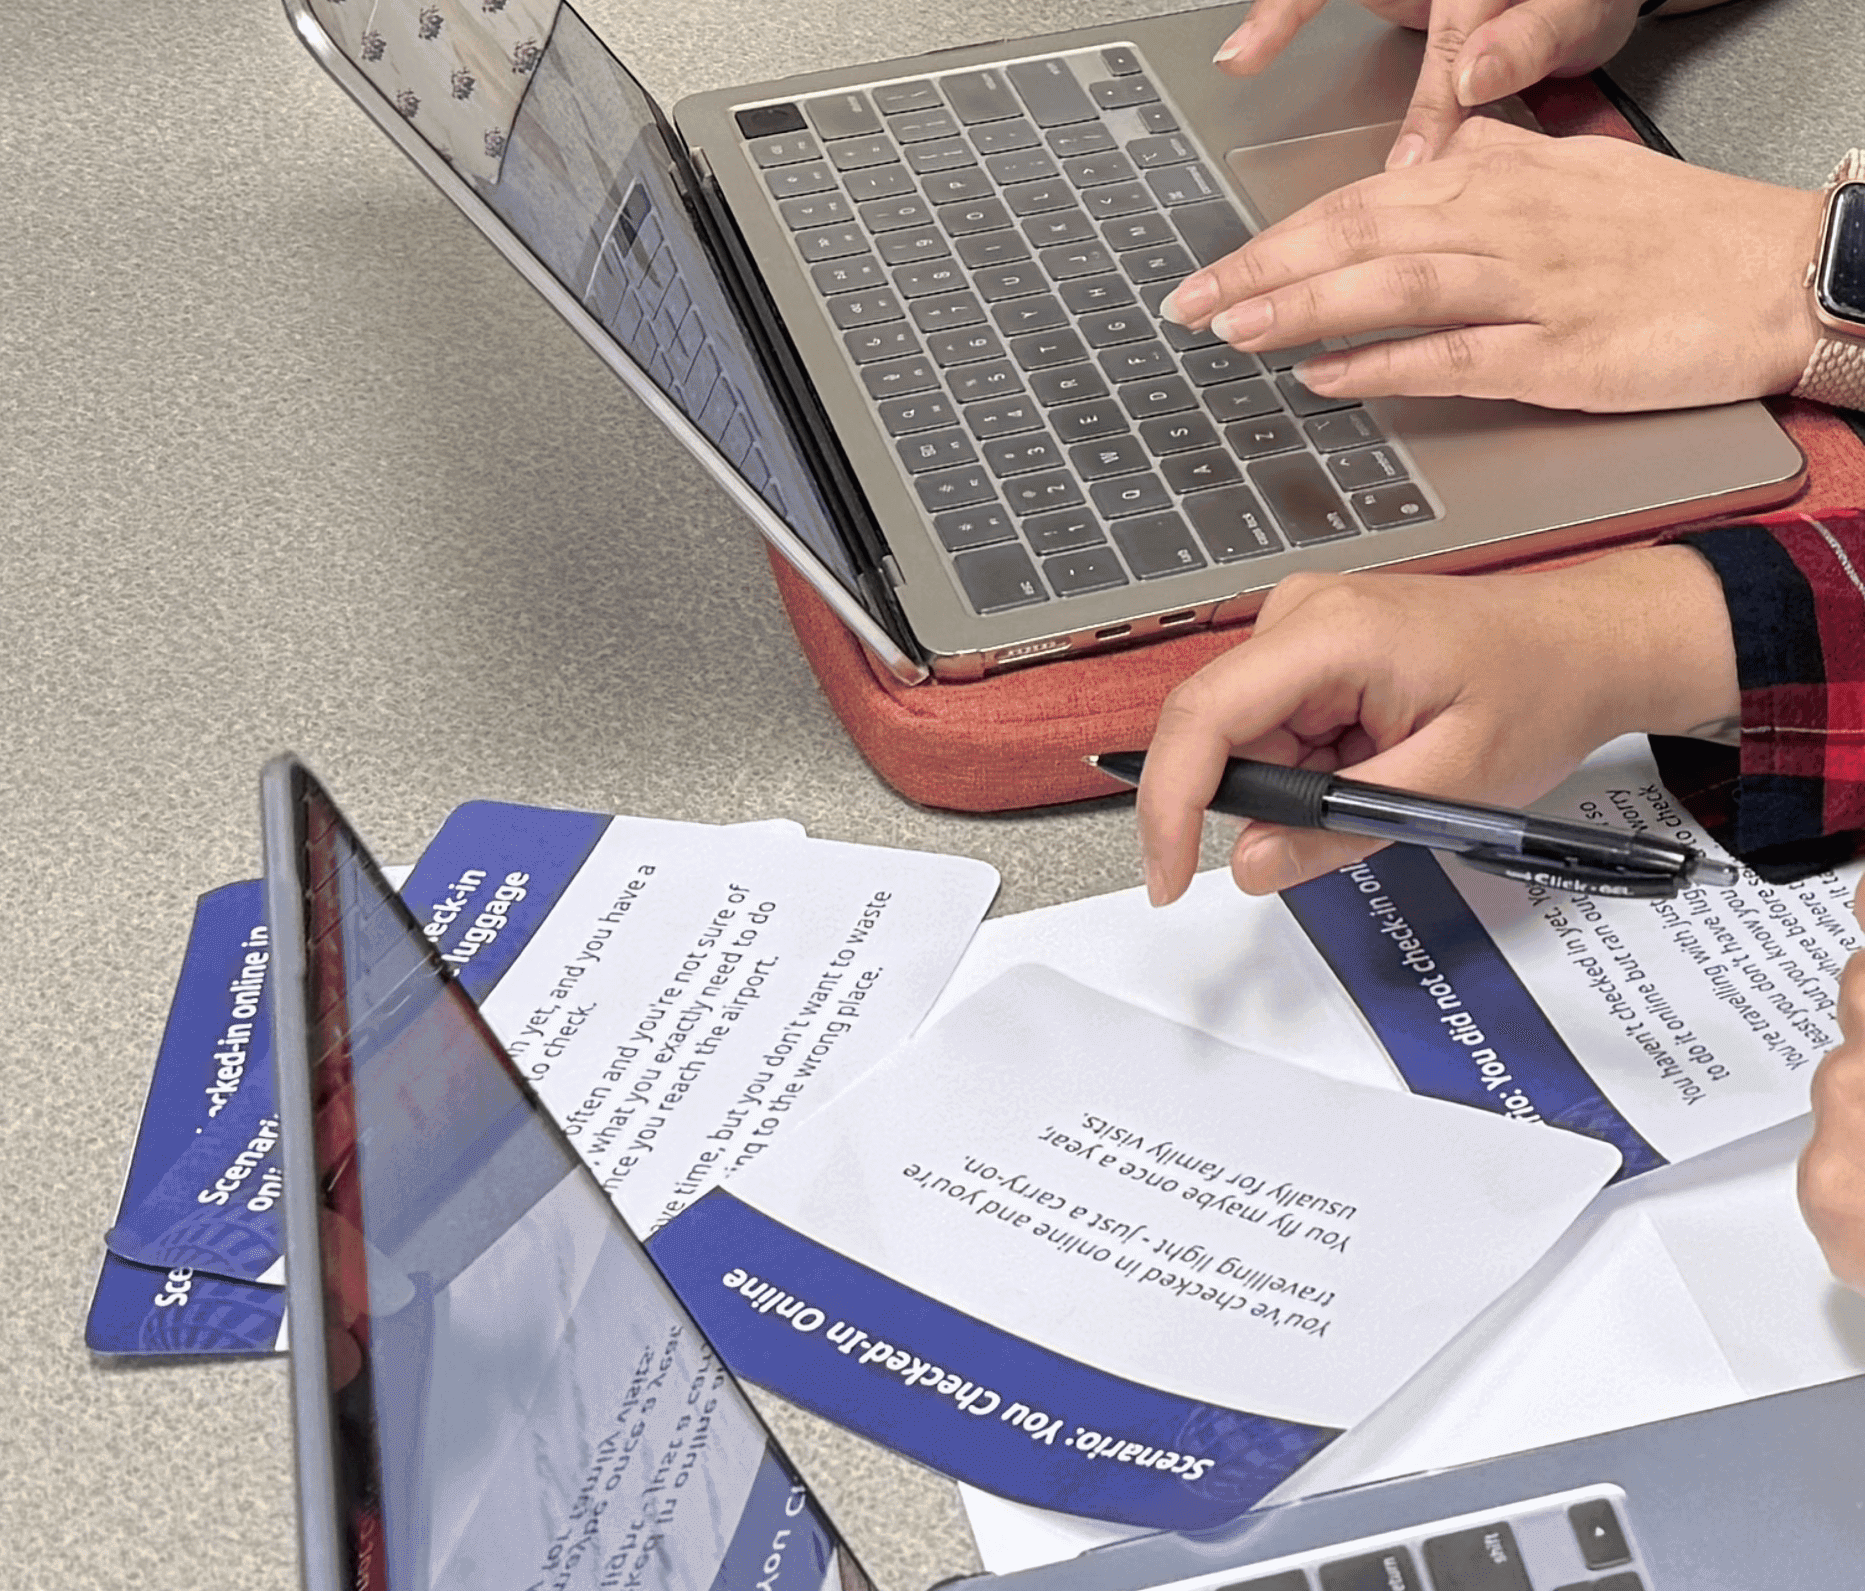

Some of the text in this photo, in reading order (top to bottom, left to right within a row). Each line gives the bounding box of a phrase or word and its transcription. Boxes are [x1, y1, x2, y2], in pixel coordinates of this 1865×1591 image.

[1340, 864, 1382, 894] onl
[1829, 886, 1851, 900] it
[423, 869, 487, 943] eck-in
[440, 871, 529, 963] luggage
[1544, 907, 1584, 939] yet.
[1649, 893, 1693, 930] just
[1682, 889, 1713, 917] lug
[1720, 889, 1761, 919] you
[1757, 889, 1808, 939] before
[1798, 892, 1846, 938] where
[241, 926, 269, 948] in
[520, 1005, 562, 1038] yet,
[550, 965, 587, 1000] and
[576, 929, 614, 964] you
[598, 880, 647, 924] have
[637, 865, 657, 877] a
[1369, 896, 1436, 973] check-in
[1566, 938, 1588, 957] in
[1673, 929, 1712, 966] with
[1704, 916, 1743, 956] have
[1743, 920, 1788, 962] know
[229, 952, 270, 1020] online
[1420, 974, 1462, 1011] not
[1571, 887, 1731, 1082] to do it online but ran out
[1572, 956, 1637, 1021] checked
[1732, 954, 1776, 993] don't
[1778, 960, 1821, 989] you
[566, 883, 751, 1136] often and you're not sure of
[1703, 964, 1771, 1033] travelling
[1767, 993, 1810, 1021] you
[1802, 986, 1836, 1013] but
[519, 1002, 598, 1082] to check.
[587, 902, 777, 1154] what you exactly need to do
[673, 1147, 727, 1196] time,
[706, 1109, 750, 1141] but
[737, 1072, 775, 1107] you
[763, 1020, 811, 1068] don't
[799, 972, 844, 1017] want
[829, 949, 857, 968] to
[846, 891, 893, 944] waste
[1440, 1012, 1486, 1047] did
[1791, 1017, 1832, 1051] least
[605, 956, 780, 1190] nce you reach the airport.
[752, 1117, 781, 1137] to
[767, 1083, 805, 1113] the
[794, 1021, 853, 1078] wrong
[837, 967, 884, 1018] place.
[1471, 1048, 1513, 1092] You
[1625, 1022, 1684, 1080] haven't
[1762, 1031, 1810, 1072] You're
[1673, 1077, 1707, 1107] You
[198, 1114, 280, 1206] Scenari
[1082, 1113, 1358, 1221] usually for family visits.
[964, 1155, 1067, 1211] carry-on.
[1038, 1126, 1352, 1254] You fly maybe once a year,
[1069, 1206, 1089, 1220] a
[1087, 1213, 1148, 1245] just
[903, 1164, 1332, 1339] You've checked in online and you're
[1152, 1239, 1215, 1274] light
[1215, 1257, 1336, 1308] travelling
[722, 1268, 1216, 1481] Scenario: You Checked-In Online
